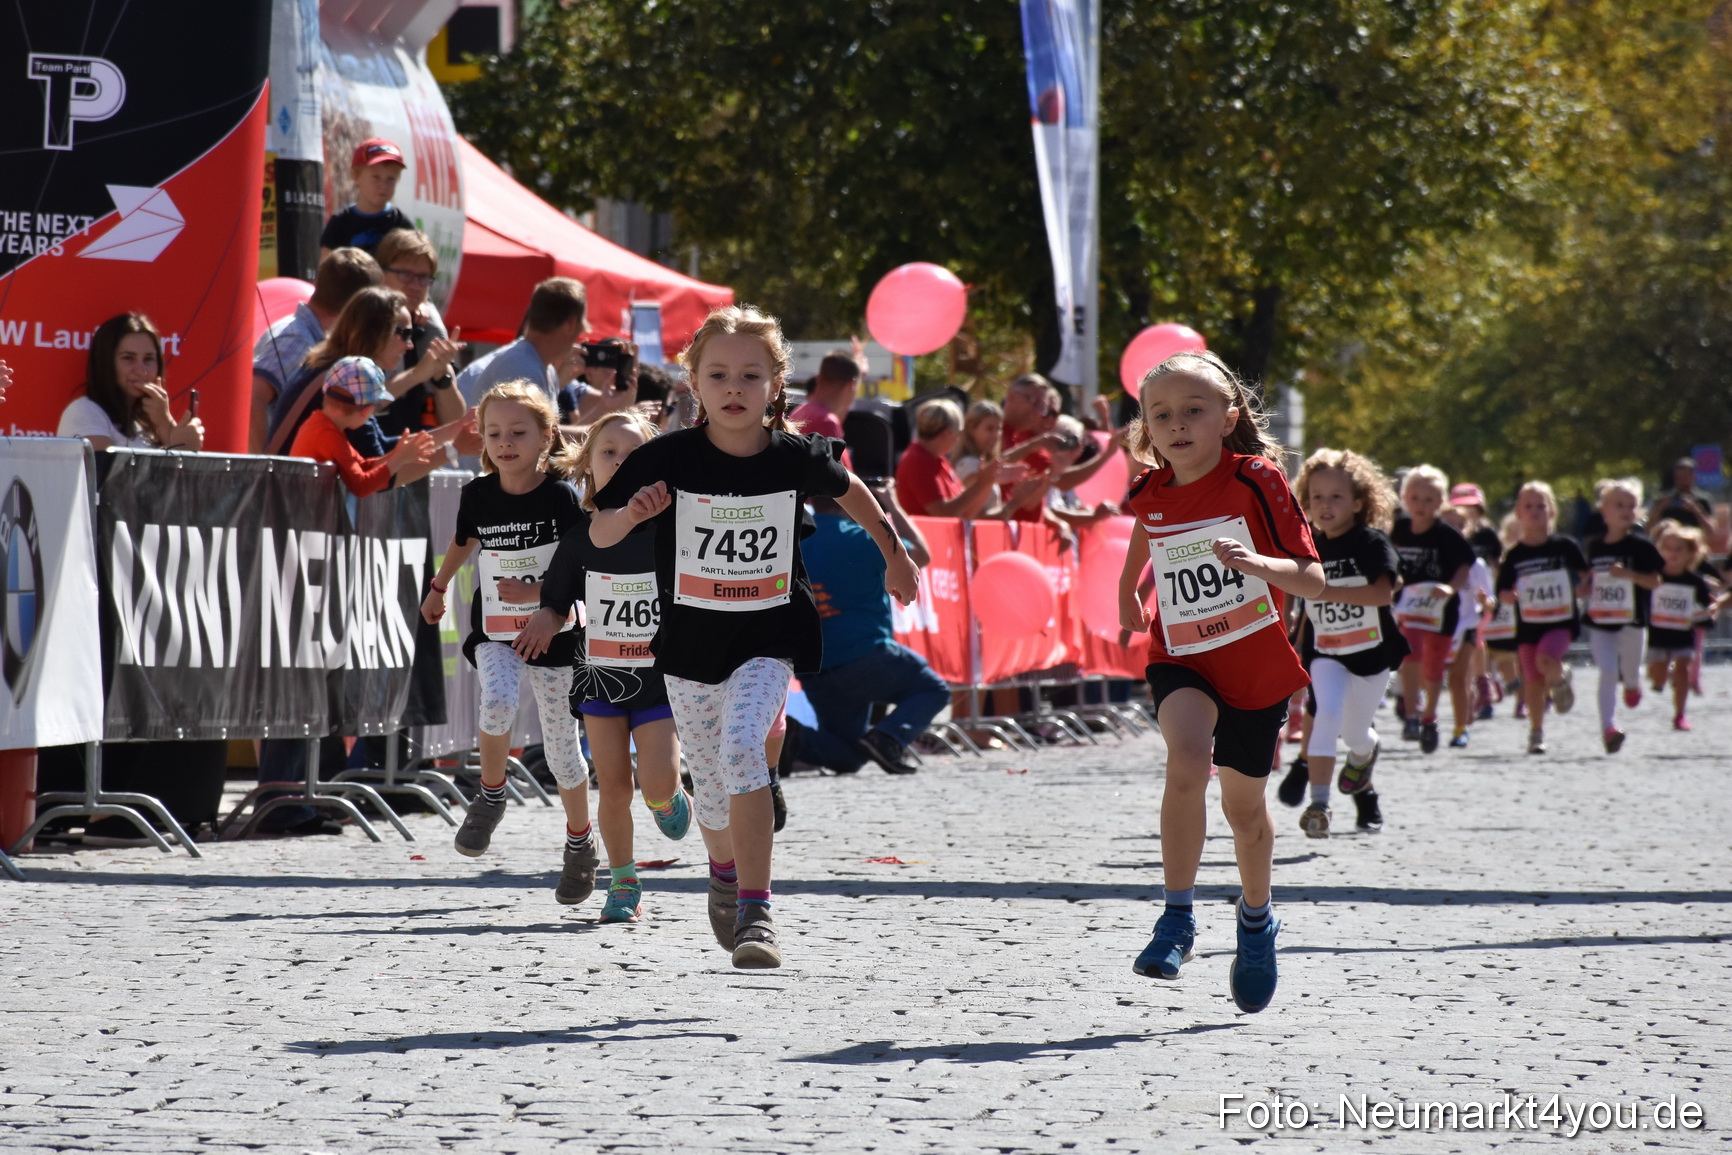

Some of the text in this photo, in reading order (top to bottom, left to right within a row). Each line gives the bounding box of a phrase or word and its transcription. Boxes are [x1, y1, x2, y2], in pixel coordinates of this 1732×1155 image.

[34, 61, 91, 74] Team Partl
[36, 213, 94, 236] NEXT
[0, 234, 64, 257] YEARS
[711, 505, 764, 519] BOCK
[477, 522, 532, 535] Neumarkter
[681, 549, 689, 557] B1
[695, 526, 778, 563] 7432
[1166, 539, 1213, 561] BOCK
[500, 556, 538, 569] BOCK
[701, 566, 763, 576] PARTL Neumarkt
[612, 581, 653, 592] BOCK
[713, 583, 759, 598] Emma
[1163, 563, 1245, 606] 7094
[1526, 585, 1562, 602] 7441
[112, 520, 241, 669] MINI
[600, 598, 661, 628] 7469
[1179, 599, 1234, 618] PARTL Neumarkt
[1313, 602, 1365, 624] 7535
[1197, 617, 1230, 638] Leni
[619, 644, 650, 656] Frida
